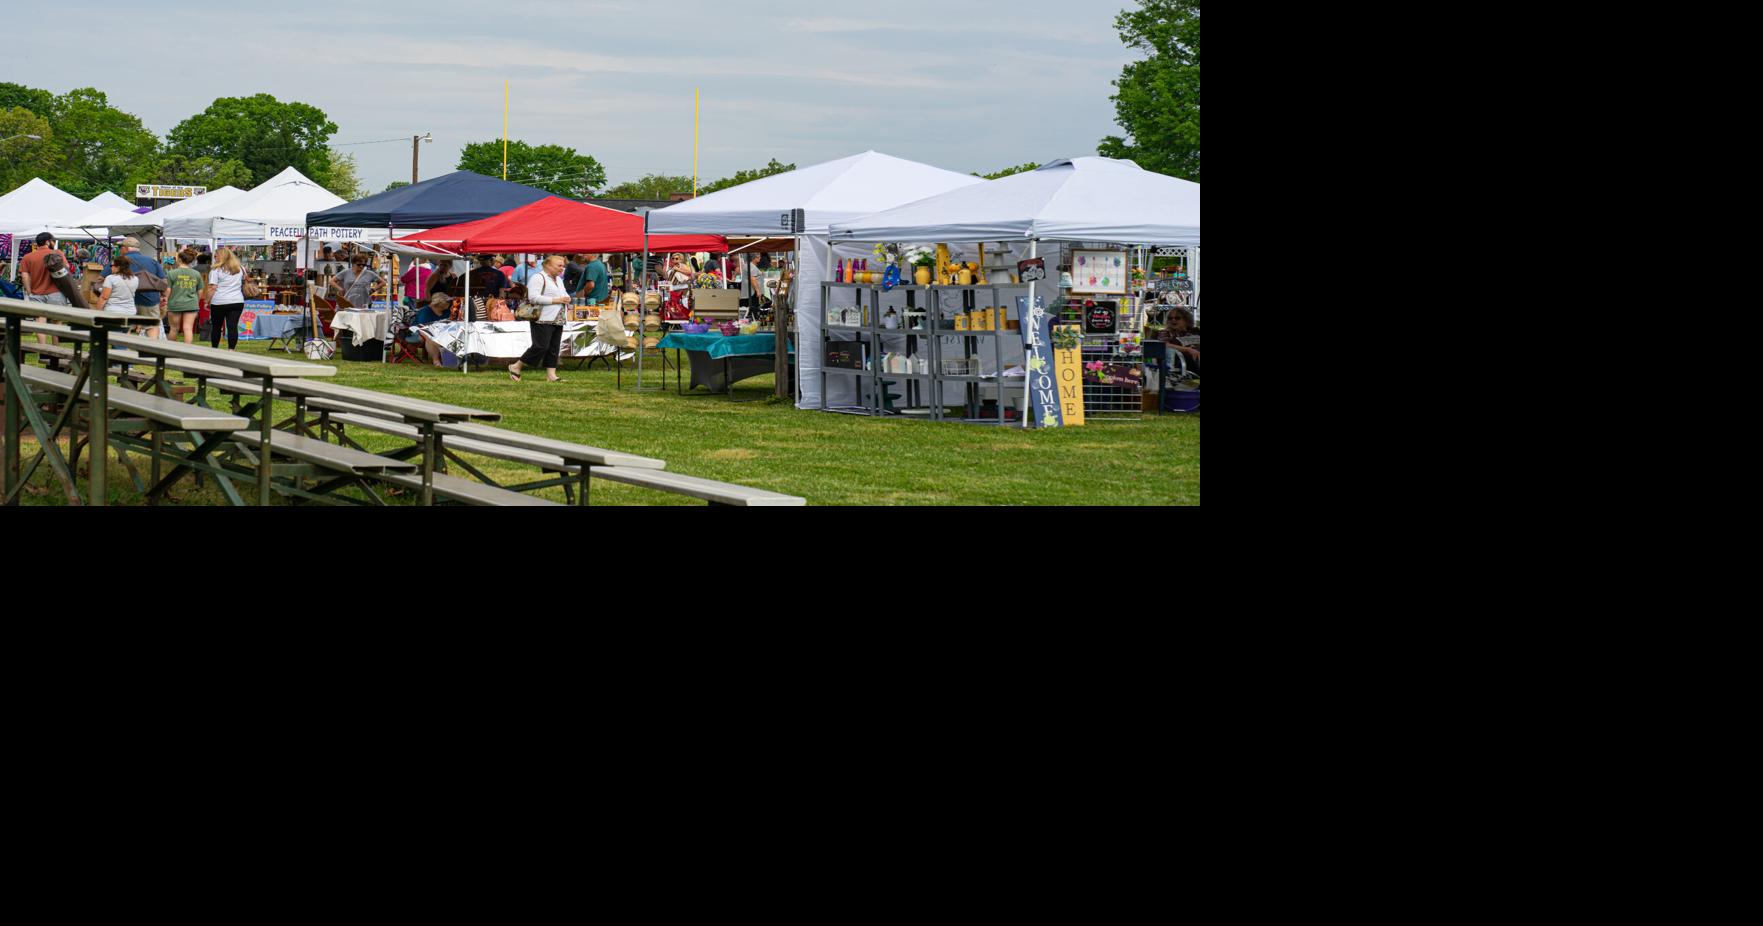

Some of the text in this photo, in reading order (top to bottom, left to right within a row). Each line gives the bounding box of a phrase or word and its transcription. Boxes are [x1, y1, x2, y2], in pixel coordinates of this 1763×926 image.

[310, 228, 327, 238] PATH
[331, 229, 362, 238] POTTERY
[1062, 352, 1076, 415] HOME
